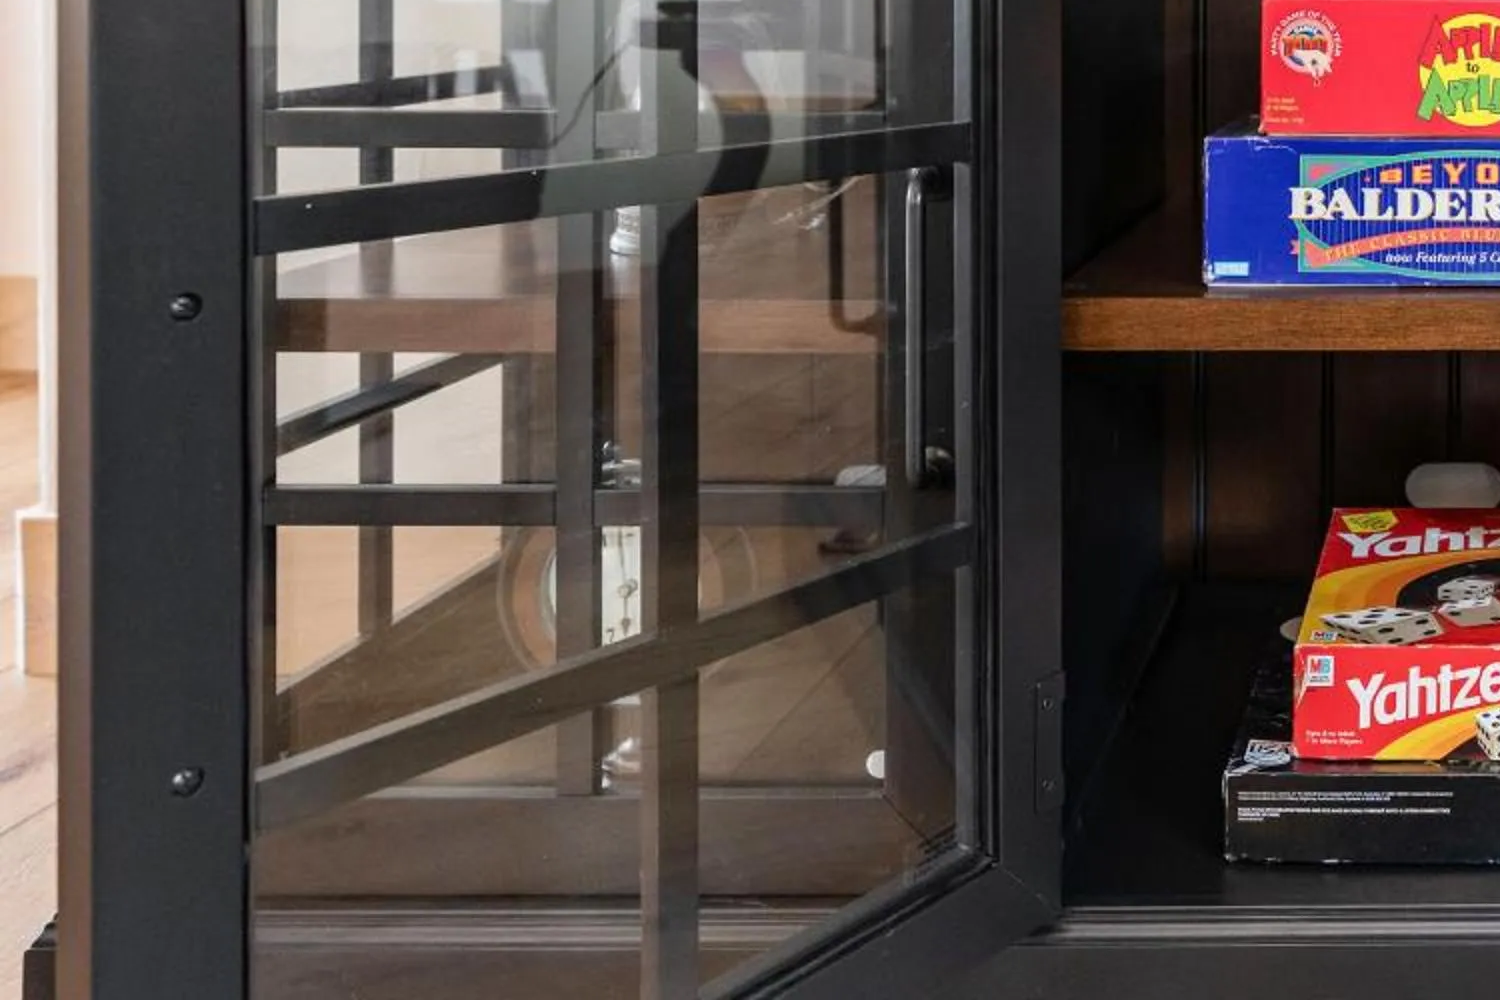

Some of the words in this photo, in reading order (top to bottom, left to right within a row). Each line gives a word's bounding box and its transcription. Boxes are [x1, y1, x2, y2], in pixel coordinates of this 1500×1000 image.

[1466, 62, 1480, 73] to
[1325, 242, 1361, 262] THE
[1369, 229, 1450, 250] CLASSIC
[1415, 251, 1477, 265] Featuring
[1479, 252, 1488, 263] 5
[1311, 658, 1331, 675] MB
